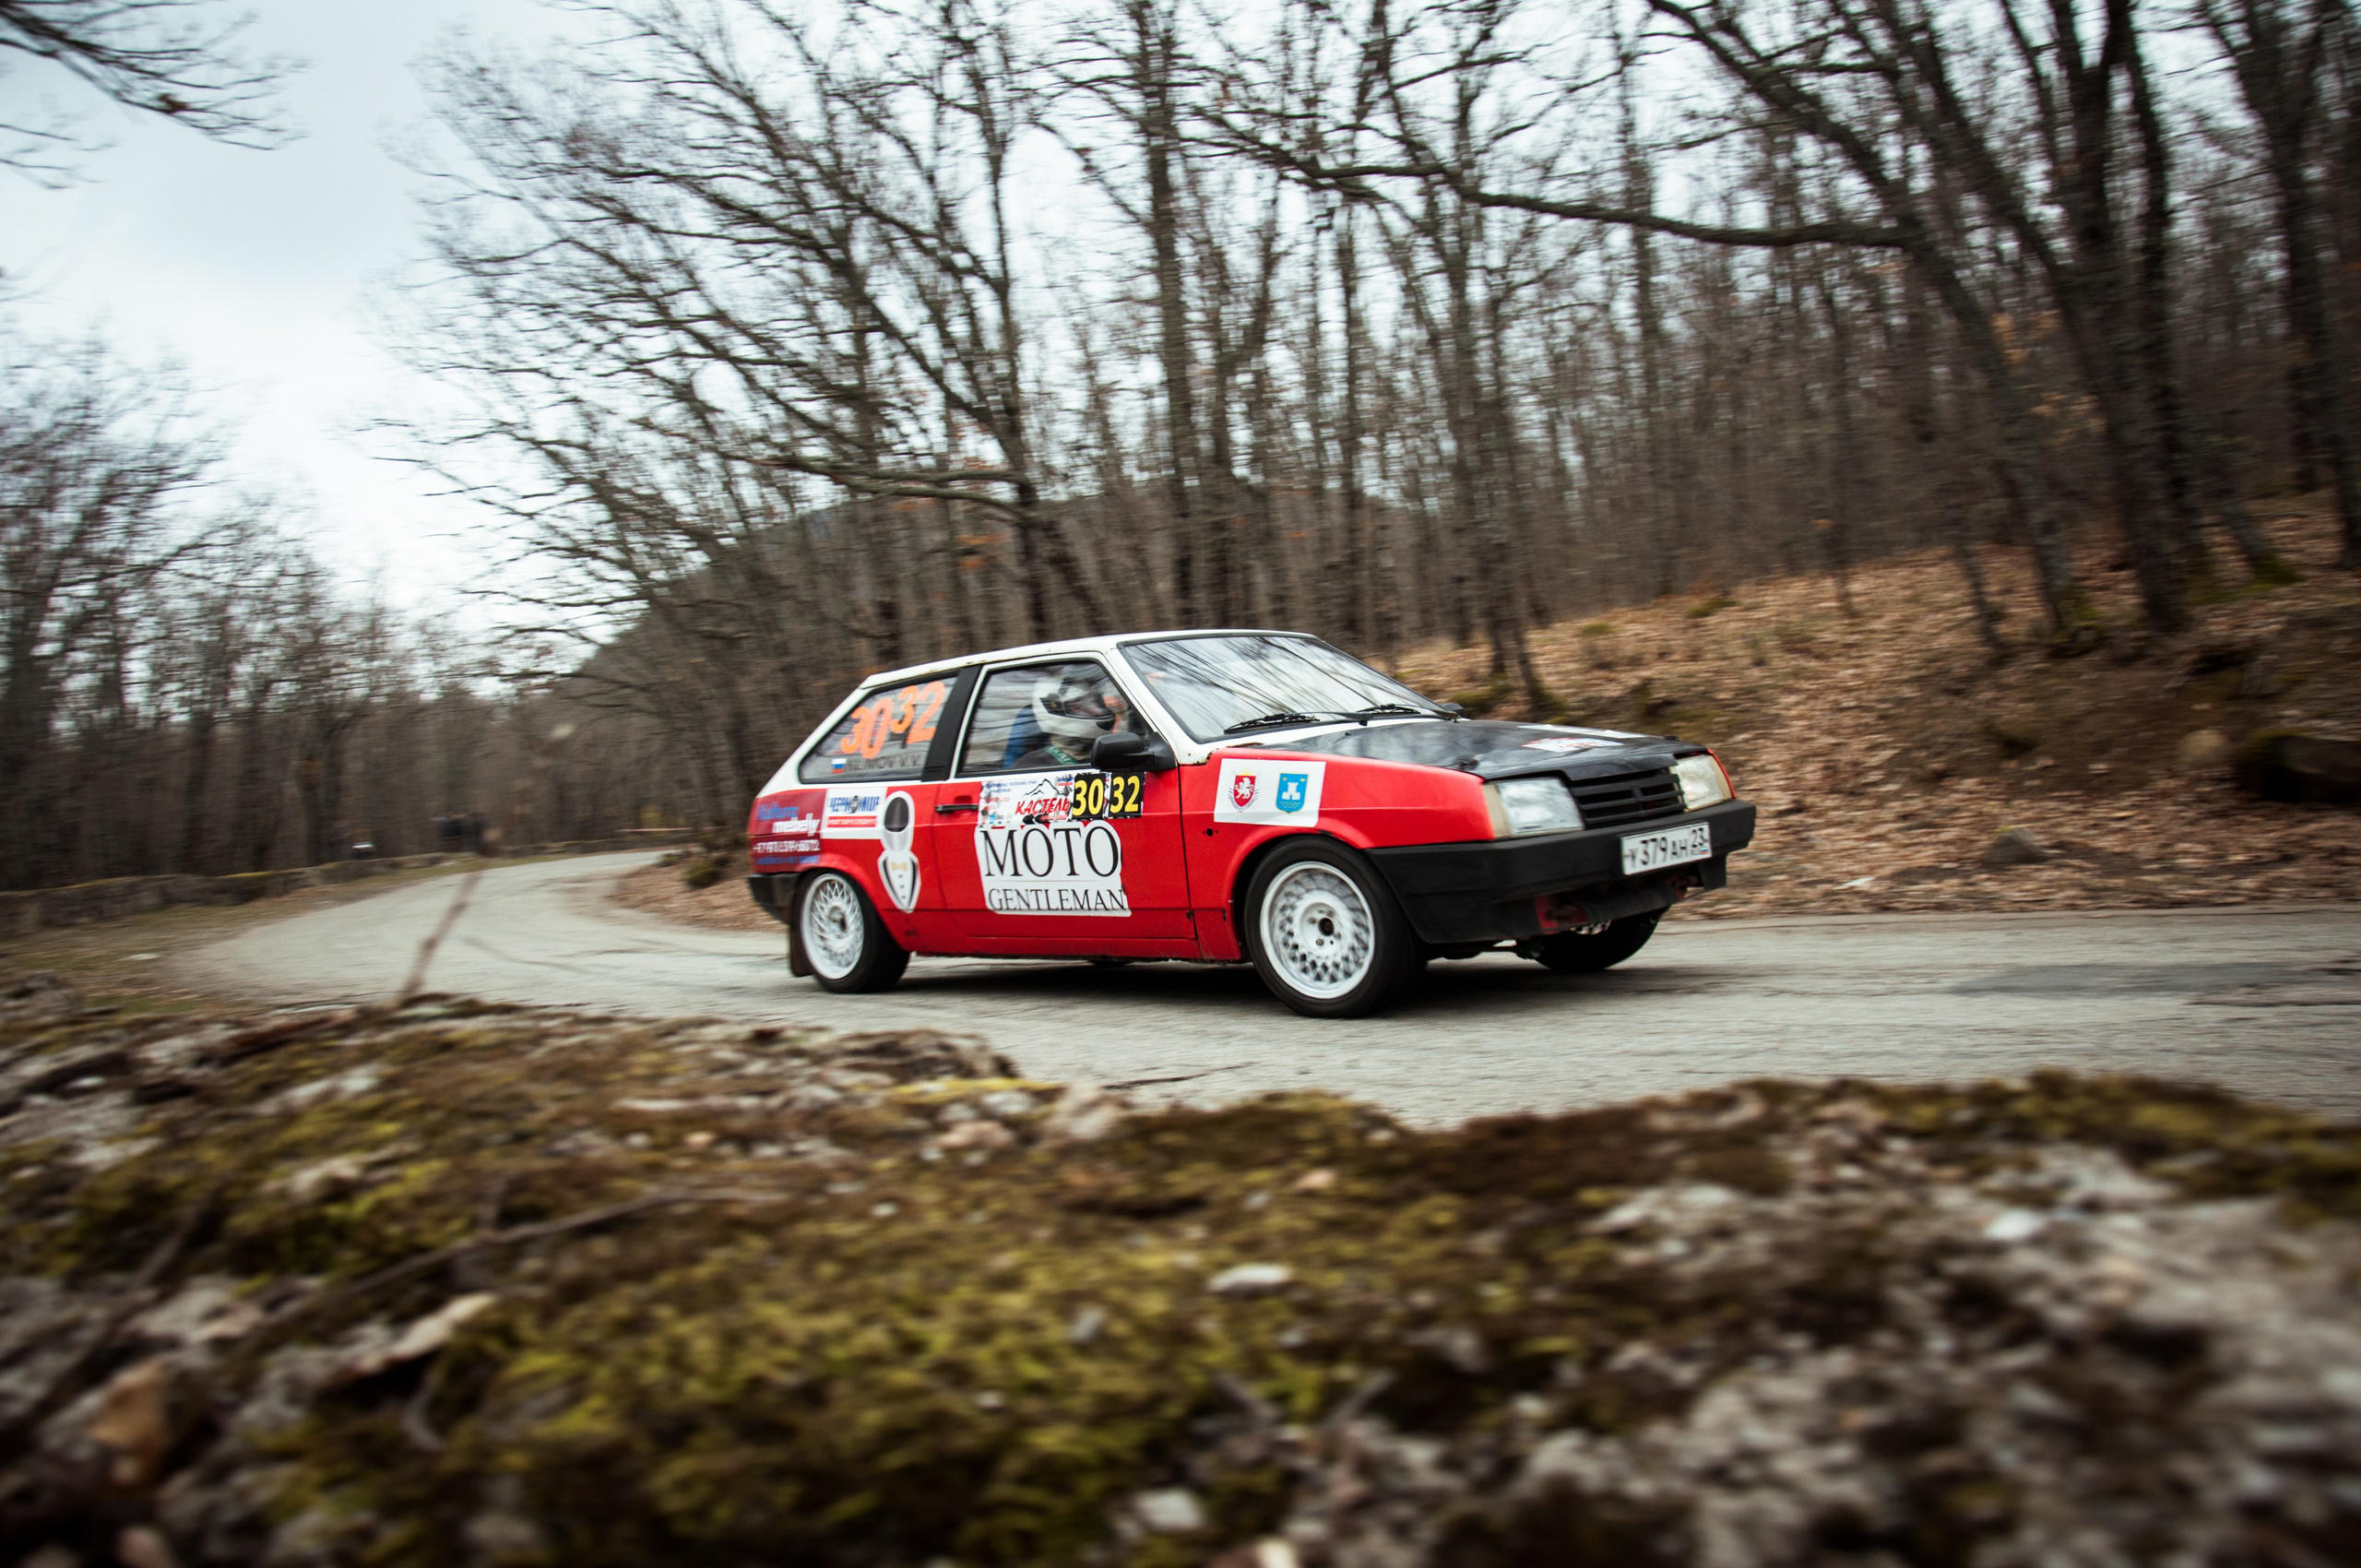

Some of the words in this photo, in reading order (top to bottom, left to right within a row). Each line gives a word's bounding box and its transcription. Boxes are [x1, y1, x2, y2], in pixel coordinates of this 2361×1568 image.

[1014, 797, 1071, 815] КАСТЕЛЬ
[1072, 778, 1104, 816] 30
[1109, 776, 1141, 814] 32
[980, 826, 1119, 877] MOTO
[989, 888, 1126, 911] GENTLEMAN
